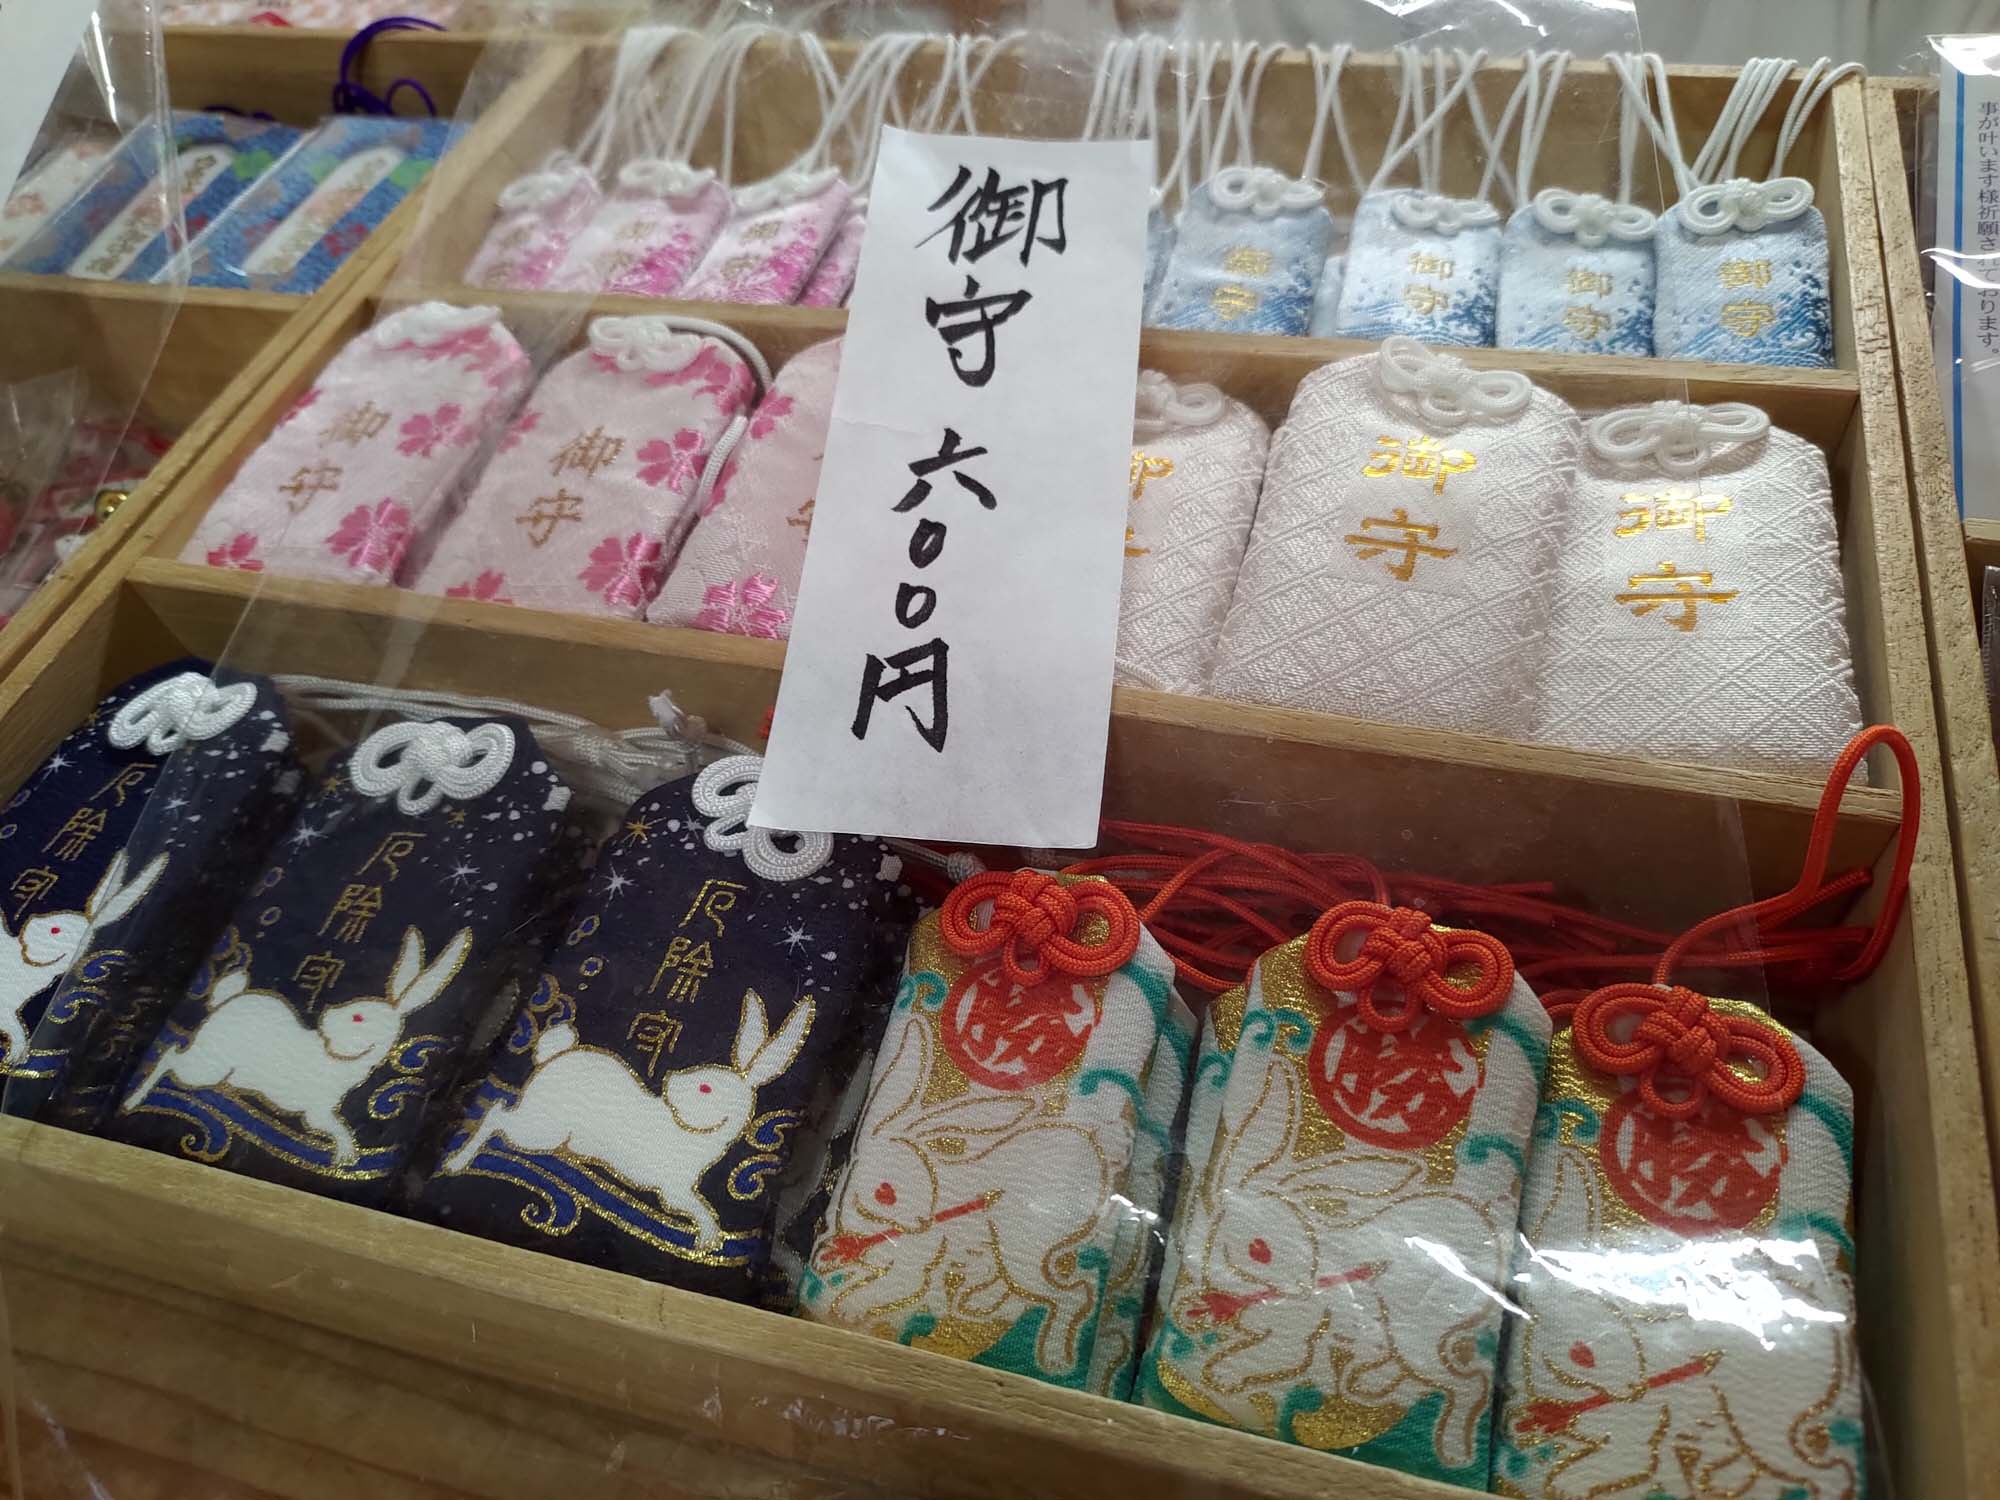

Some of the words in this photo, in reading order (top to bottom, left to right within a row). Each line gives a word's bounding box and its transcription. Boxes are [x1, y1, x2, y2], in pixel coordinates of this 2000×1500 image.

[916, 165, 1069, 387] 御守
[279, 401, 392, 513] 御守
[515, 425, 627, 547] 御守
[1344, 434, 1478, 582] 御守
[1614, 487, 1739, 632] 御守
